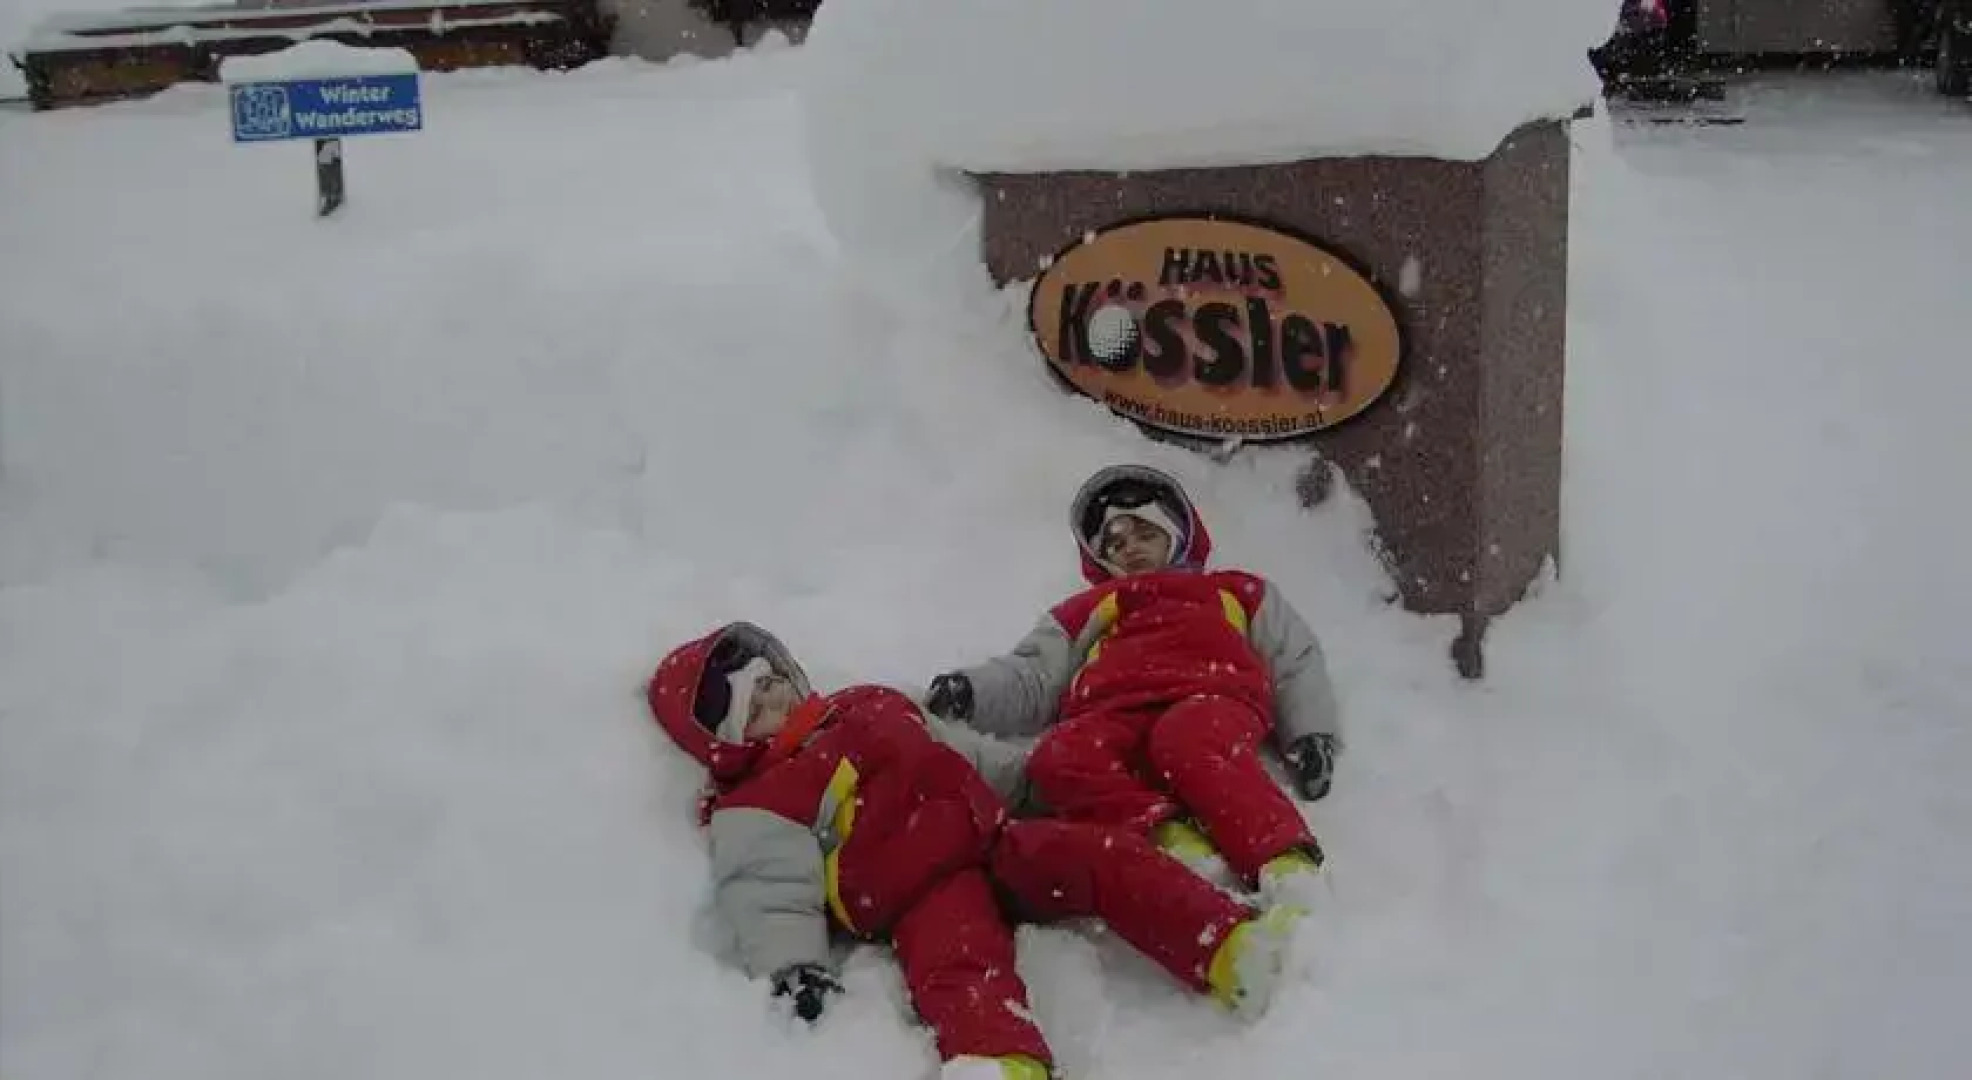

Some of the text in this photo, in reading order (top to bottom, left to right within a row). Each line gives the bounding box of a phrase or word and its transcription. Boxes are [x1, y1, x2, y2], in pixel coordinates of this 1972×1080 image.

[319, 84, 391, 104] Winter
[295, 107, 417, 127] Wanderweg
[1159, 247, 1281, 290] HAUS
[1058, 278, 1352, 394] Kössler
